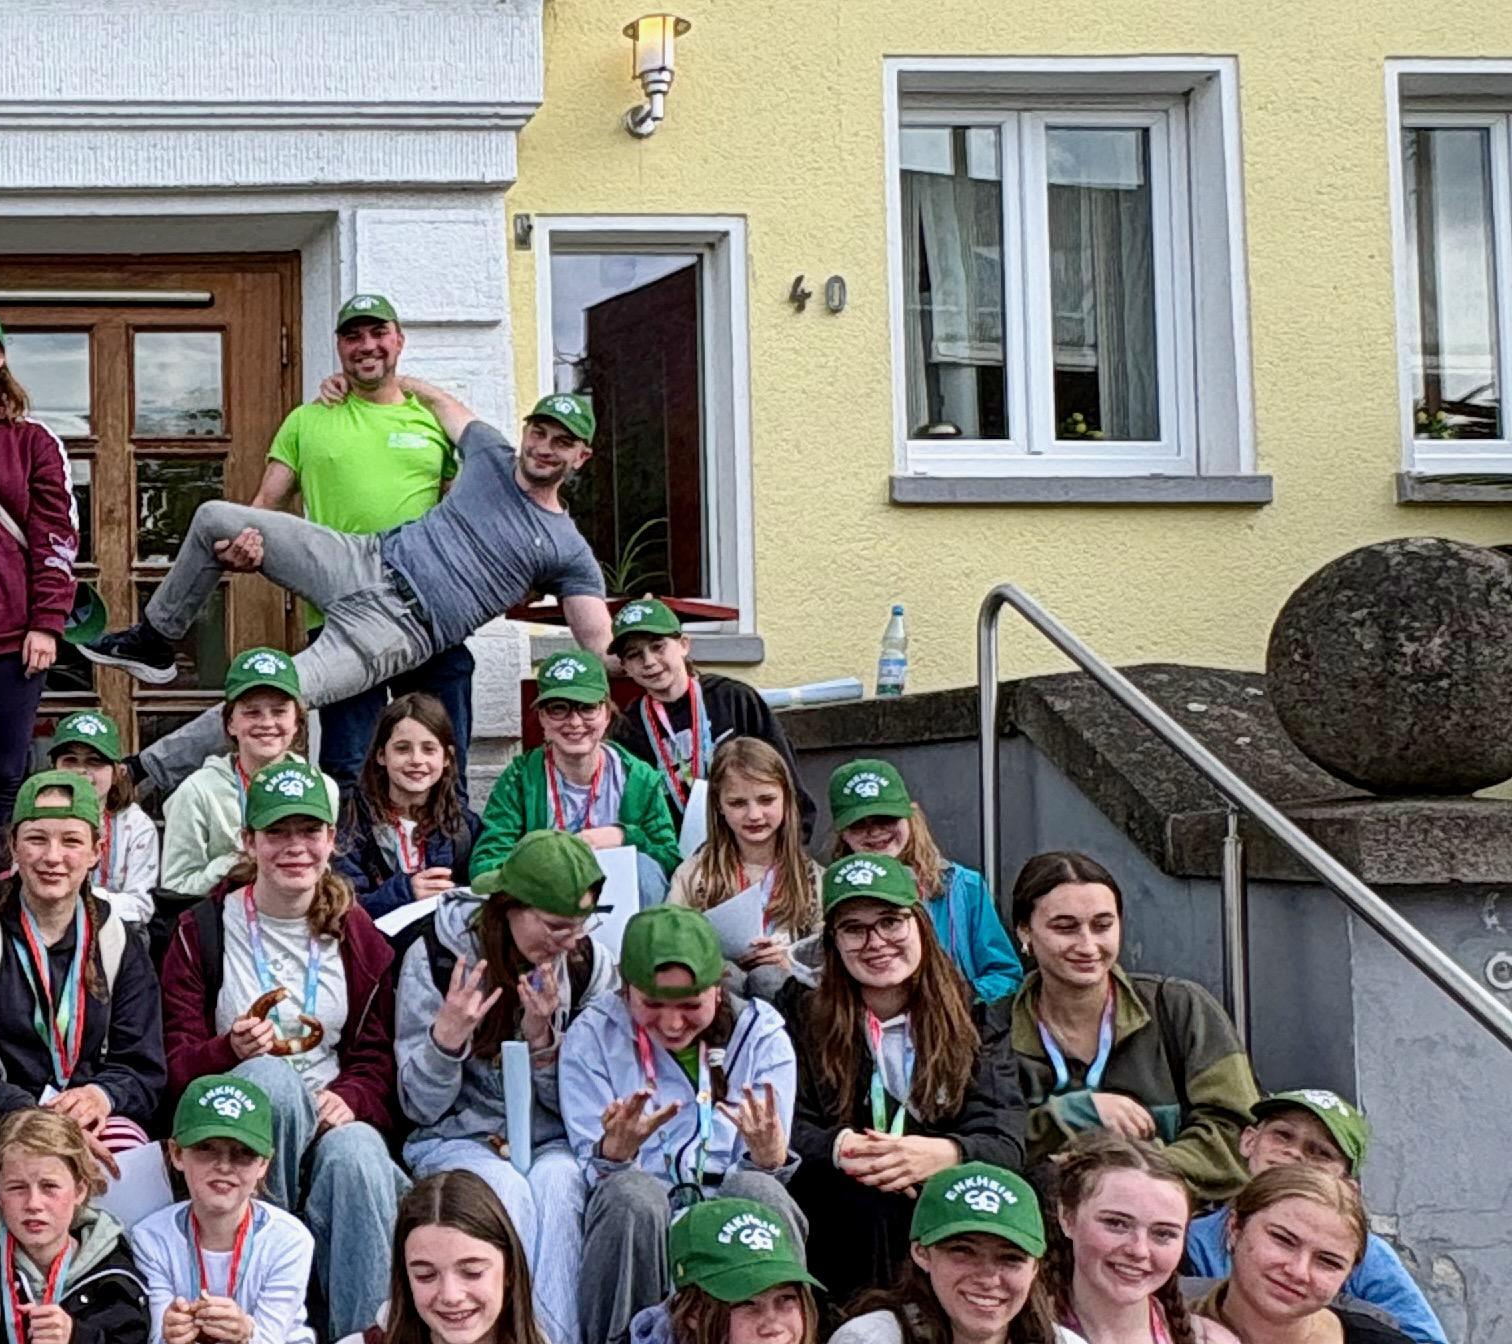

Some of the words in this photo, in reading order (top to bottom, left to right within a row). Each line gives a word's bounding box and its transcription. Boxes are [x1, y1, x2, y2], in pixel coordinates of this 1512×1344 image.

[789, 274, 846, 313] 40
[944, 1175, 1019, 1205] ENKHEIM
[964, 1189, 1001, 1214] SG
